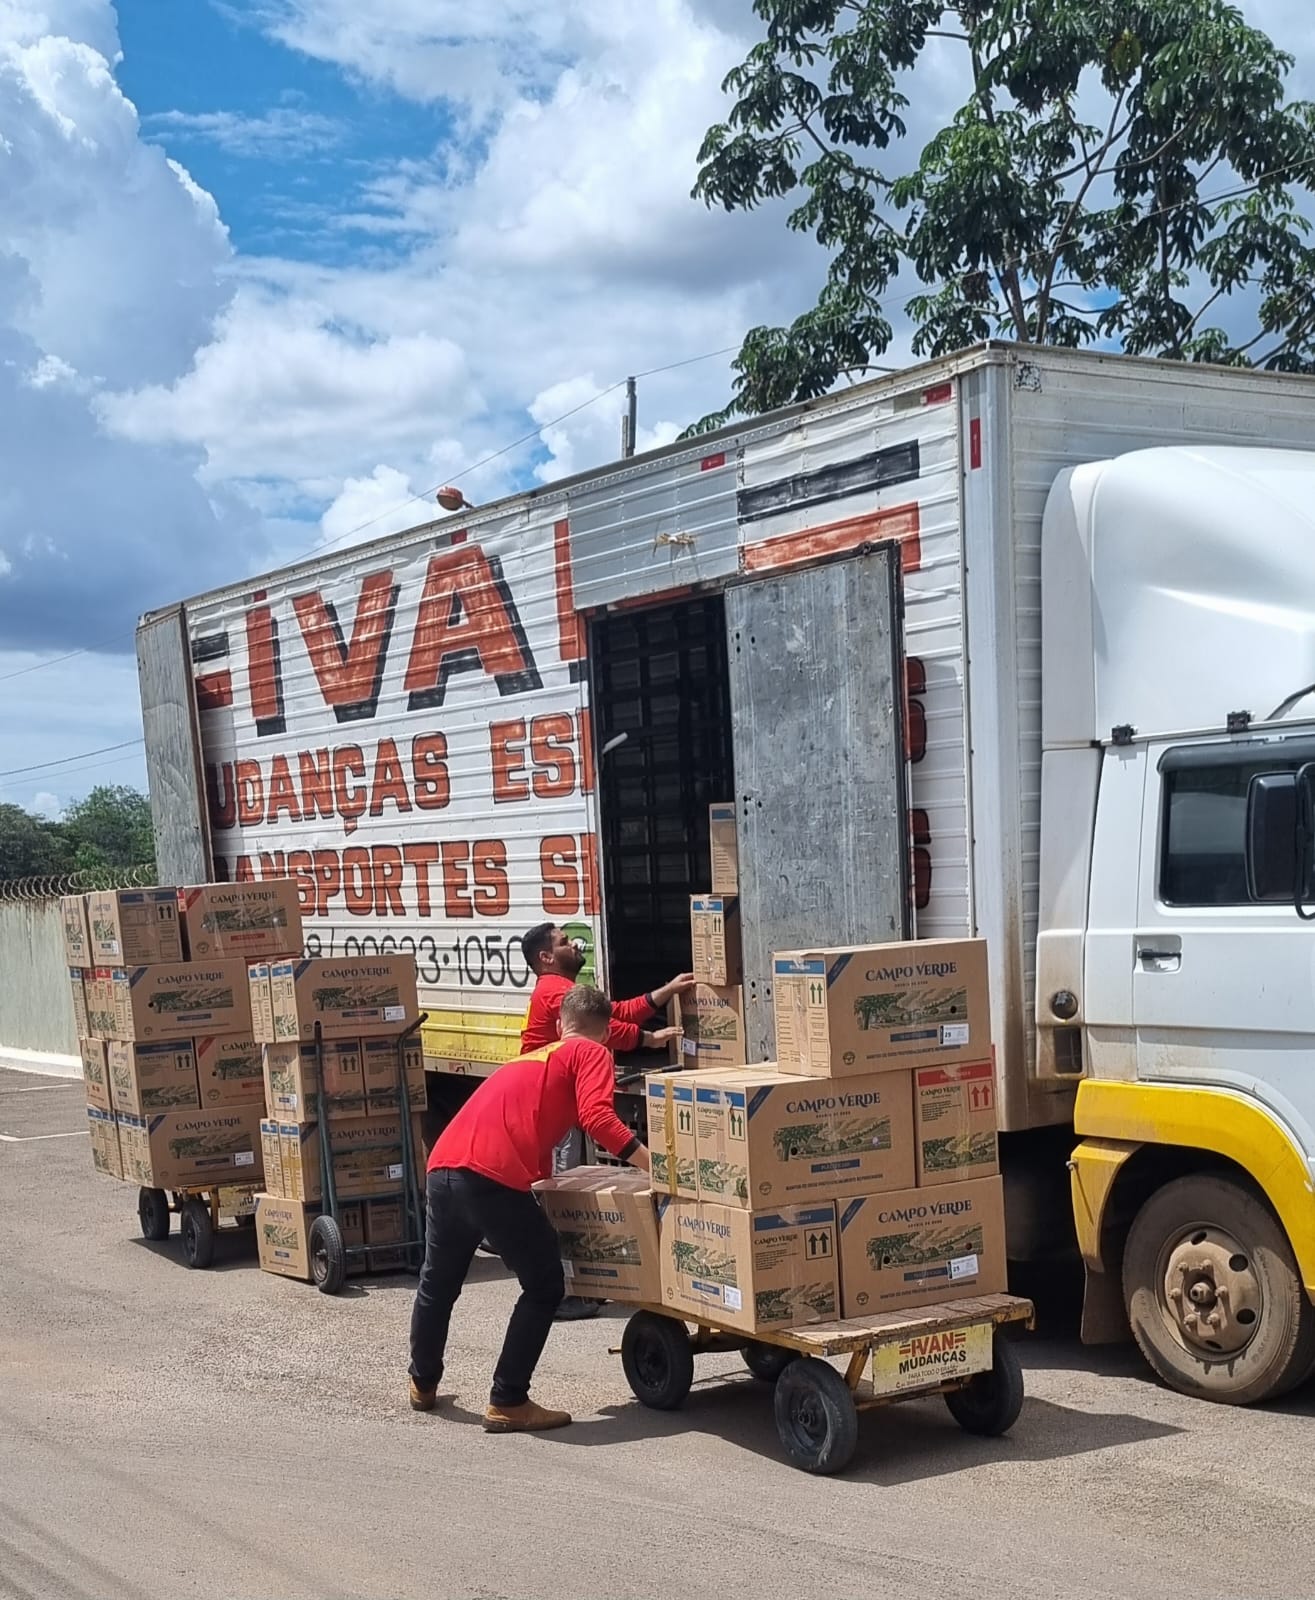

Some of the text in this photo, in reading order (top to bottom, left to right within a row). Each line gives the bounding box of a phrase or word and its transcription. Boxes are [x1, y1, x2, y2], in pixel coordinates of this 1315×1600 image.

[157, 971, 224, 985] CAMPO VERDE
[322, 967, 392, 979] CAMPO VERDE
[865, 961, 958, 982] CAMPO VERDE
[786, 1096, 836, 1115] CAMPO
[838, 1092, 881, 1108] VERDE
[175, 1117, 241, 1131] CAMPO VERDE
[878, 1200, 972, 1224] CAMPO VERDE
[677, 1215, 732, 1239] CAMPO VERDE
[754, 1233, 798, 1246] CAMPO VERDE
[911, 1332, 954, 1357] IVAN
[899, 1350, 967, 1374] MUDANÇAS
